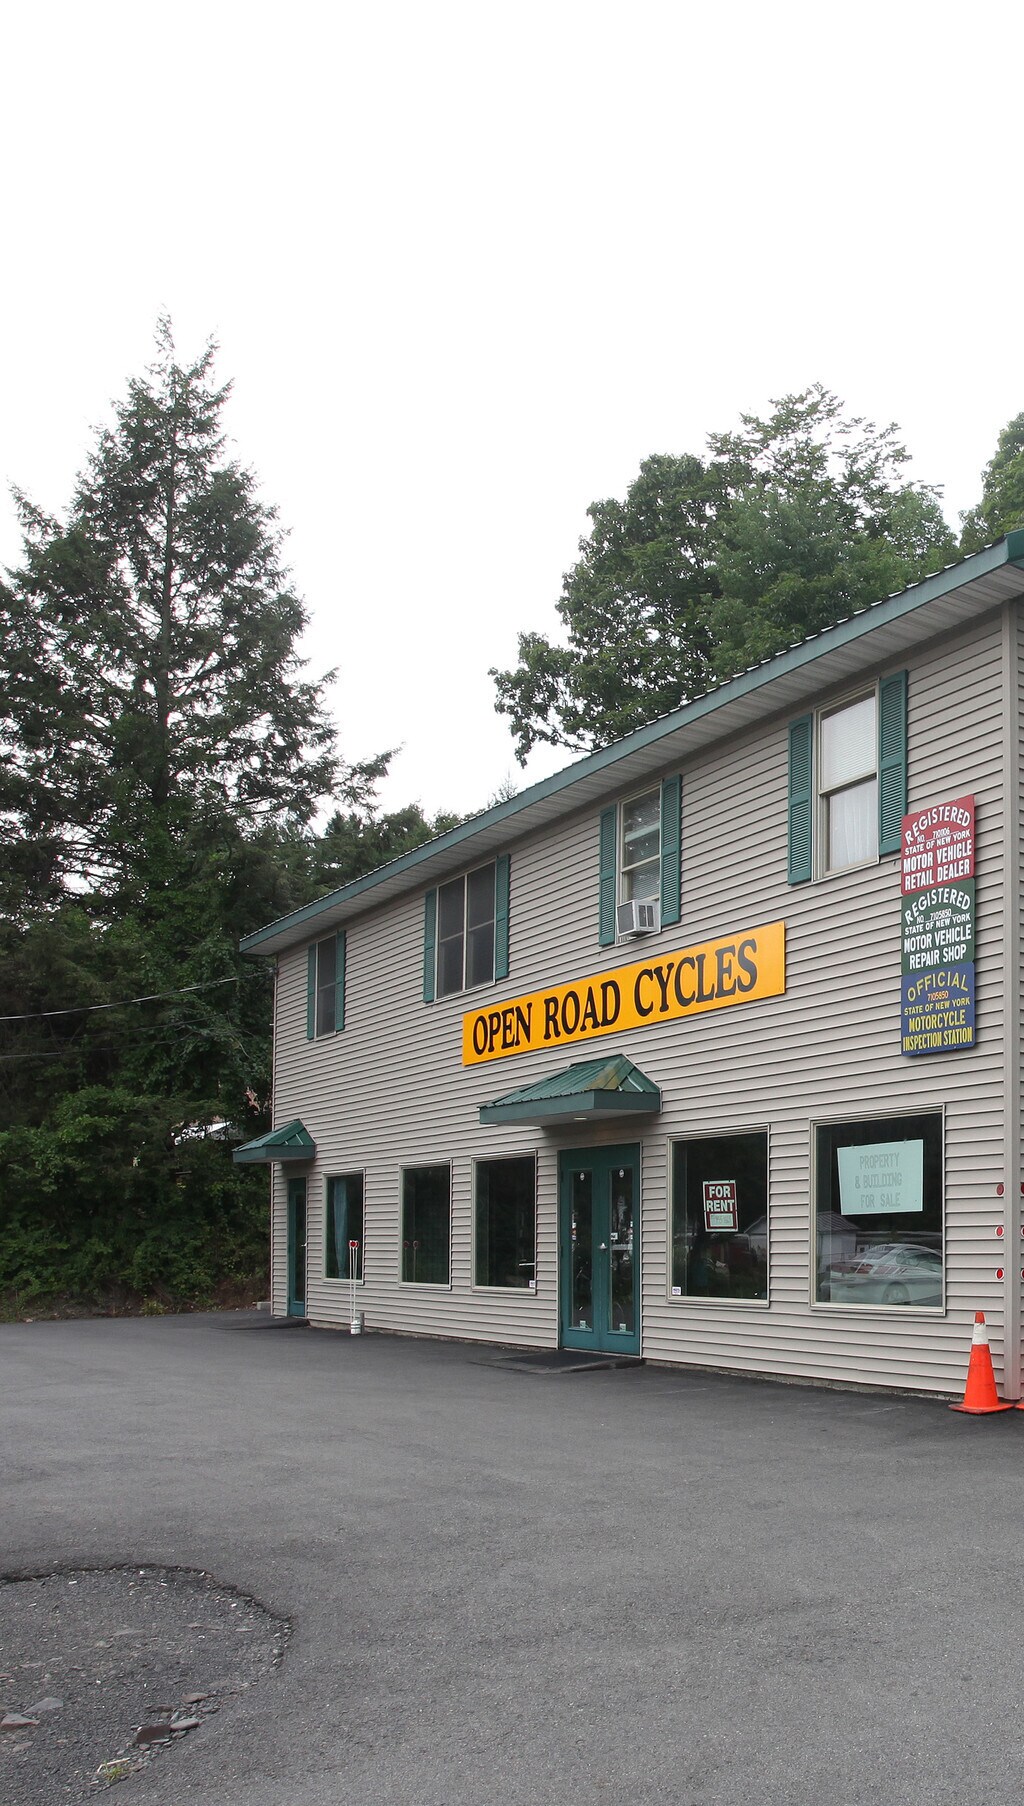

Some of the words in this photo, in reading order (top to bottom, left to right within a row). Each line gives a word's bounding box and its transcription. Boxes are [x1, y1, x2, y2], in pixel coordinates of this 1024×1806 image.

[905, 806, 971, 845] REGISTERED
[905, 843, 924, 855] STATE
[926, 840, 935, 850] OF
[936, 836, 951, 847] NEW
[953, 829, 971, 841] YORK
[903, 852, 933, 874] MOTOR
[936, 840, 972, 864] VEHICLE
[905, 869, 934, 891] RETAIL
[937, 859, 970, 882] DEALER
[905, 888, 971, 925] REGISTERED
[905, 924, 924, 935] STATE
[925, 922, 934, 931] OF
[936, 918, 950, 928] NEW
[952, 913, 971, 924] YORK
[904, 933, 932, 953] MOTOR
[935, 924, 972, 946] VEHICLE
[909, 949, 940, 969] REPAIR
[942, 944, 967, 963] SHOP
[473, 1002, 532, 1055] OPEN
[543, 979, 620, 1040] ROAD
[634, 938, 758, 1017] CYCLES
[907, 971, 968, 1001] OFFICIAL
[904, 1005, 923, 1016] STATE
[925, 1003, 934, 1012] OF
[935, 1001, 950, 1010] NEW
[952, 997, 970, 1007] YORK
[909, 1009, 966, 1032] MOTORCYCLE
[903, 1031, 942, 1051] INSPECTION
[943, 1026, 973, 1045] STATION
[859, 1152, 900, 1170] PROPERTY
[709, 1185, 731, 1198] FOR
[863, 1172, 903, 1188] BUILDING
[706, 1199, 735, 1212] RENT
[860, 1194, 875, 1208] FOR
[880, 1192, 901, 1207] SALE
